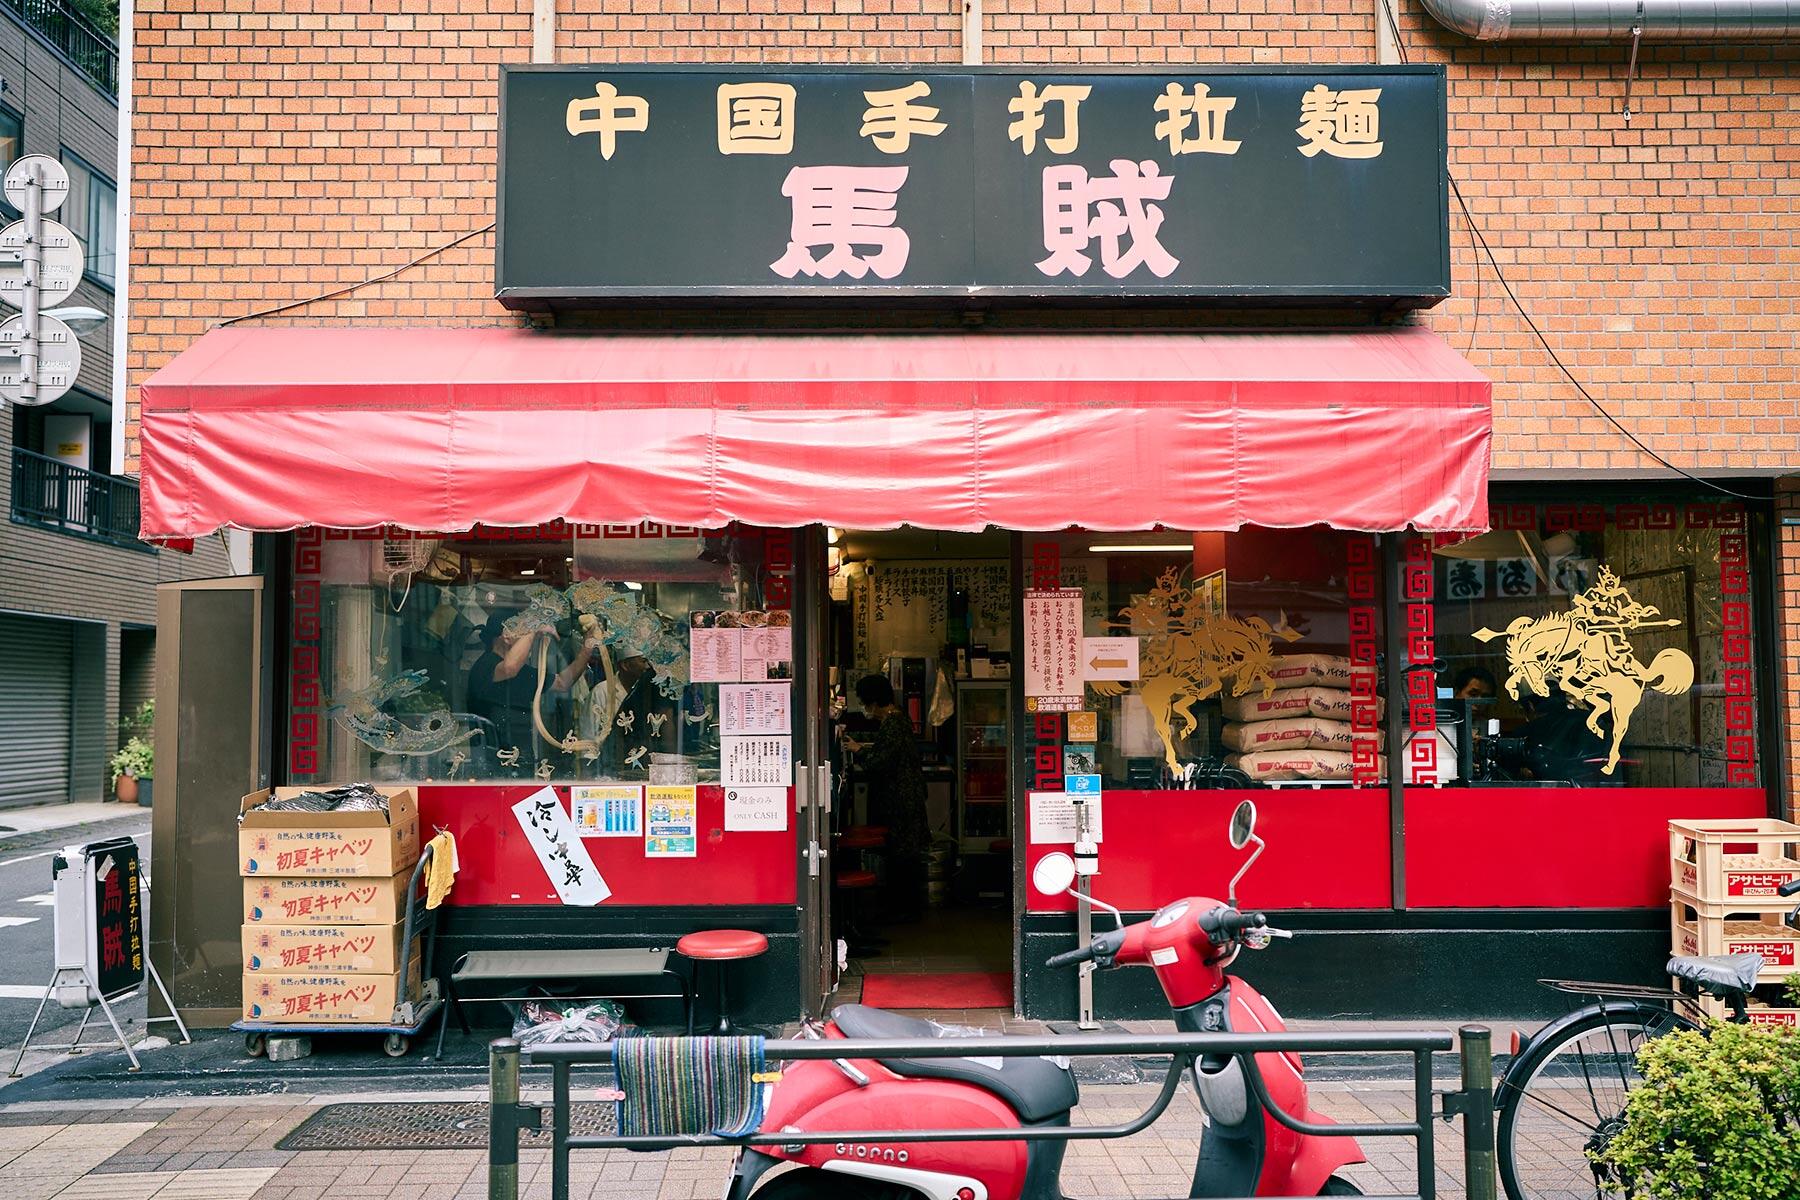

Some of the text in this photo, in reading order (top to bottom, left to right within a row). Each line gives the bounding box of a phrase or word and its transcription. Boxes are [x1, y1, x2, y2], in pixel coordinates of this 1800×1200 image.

[566, 81, 1385, 160] 中国手打拉麺
[769, 159, 1181, 280] 馬賊
[1030, 601, 1040, 673] お断りしております。
[1066, 601, 1077, 676] 当店は、20歳未満の方
[739, 796, 772, 805] 現金のみ
[754, 811, 778, 820] CASH
[277, 839, 374, 871] 初夏キャベツ
[1729, 875, 1792, 886] アサヒビール
[282, 886, 377, 918] 初夏キャベツ
[280, 935, 376, 967] 初夏キャベツ
[1731, 944, 1793, 956] アサヒビール
[282, 984, 377, 1016] 初夏キャベツ
[1749, 1014, 1795, 1025] サヒビール
